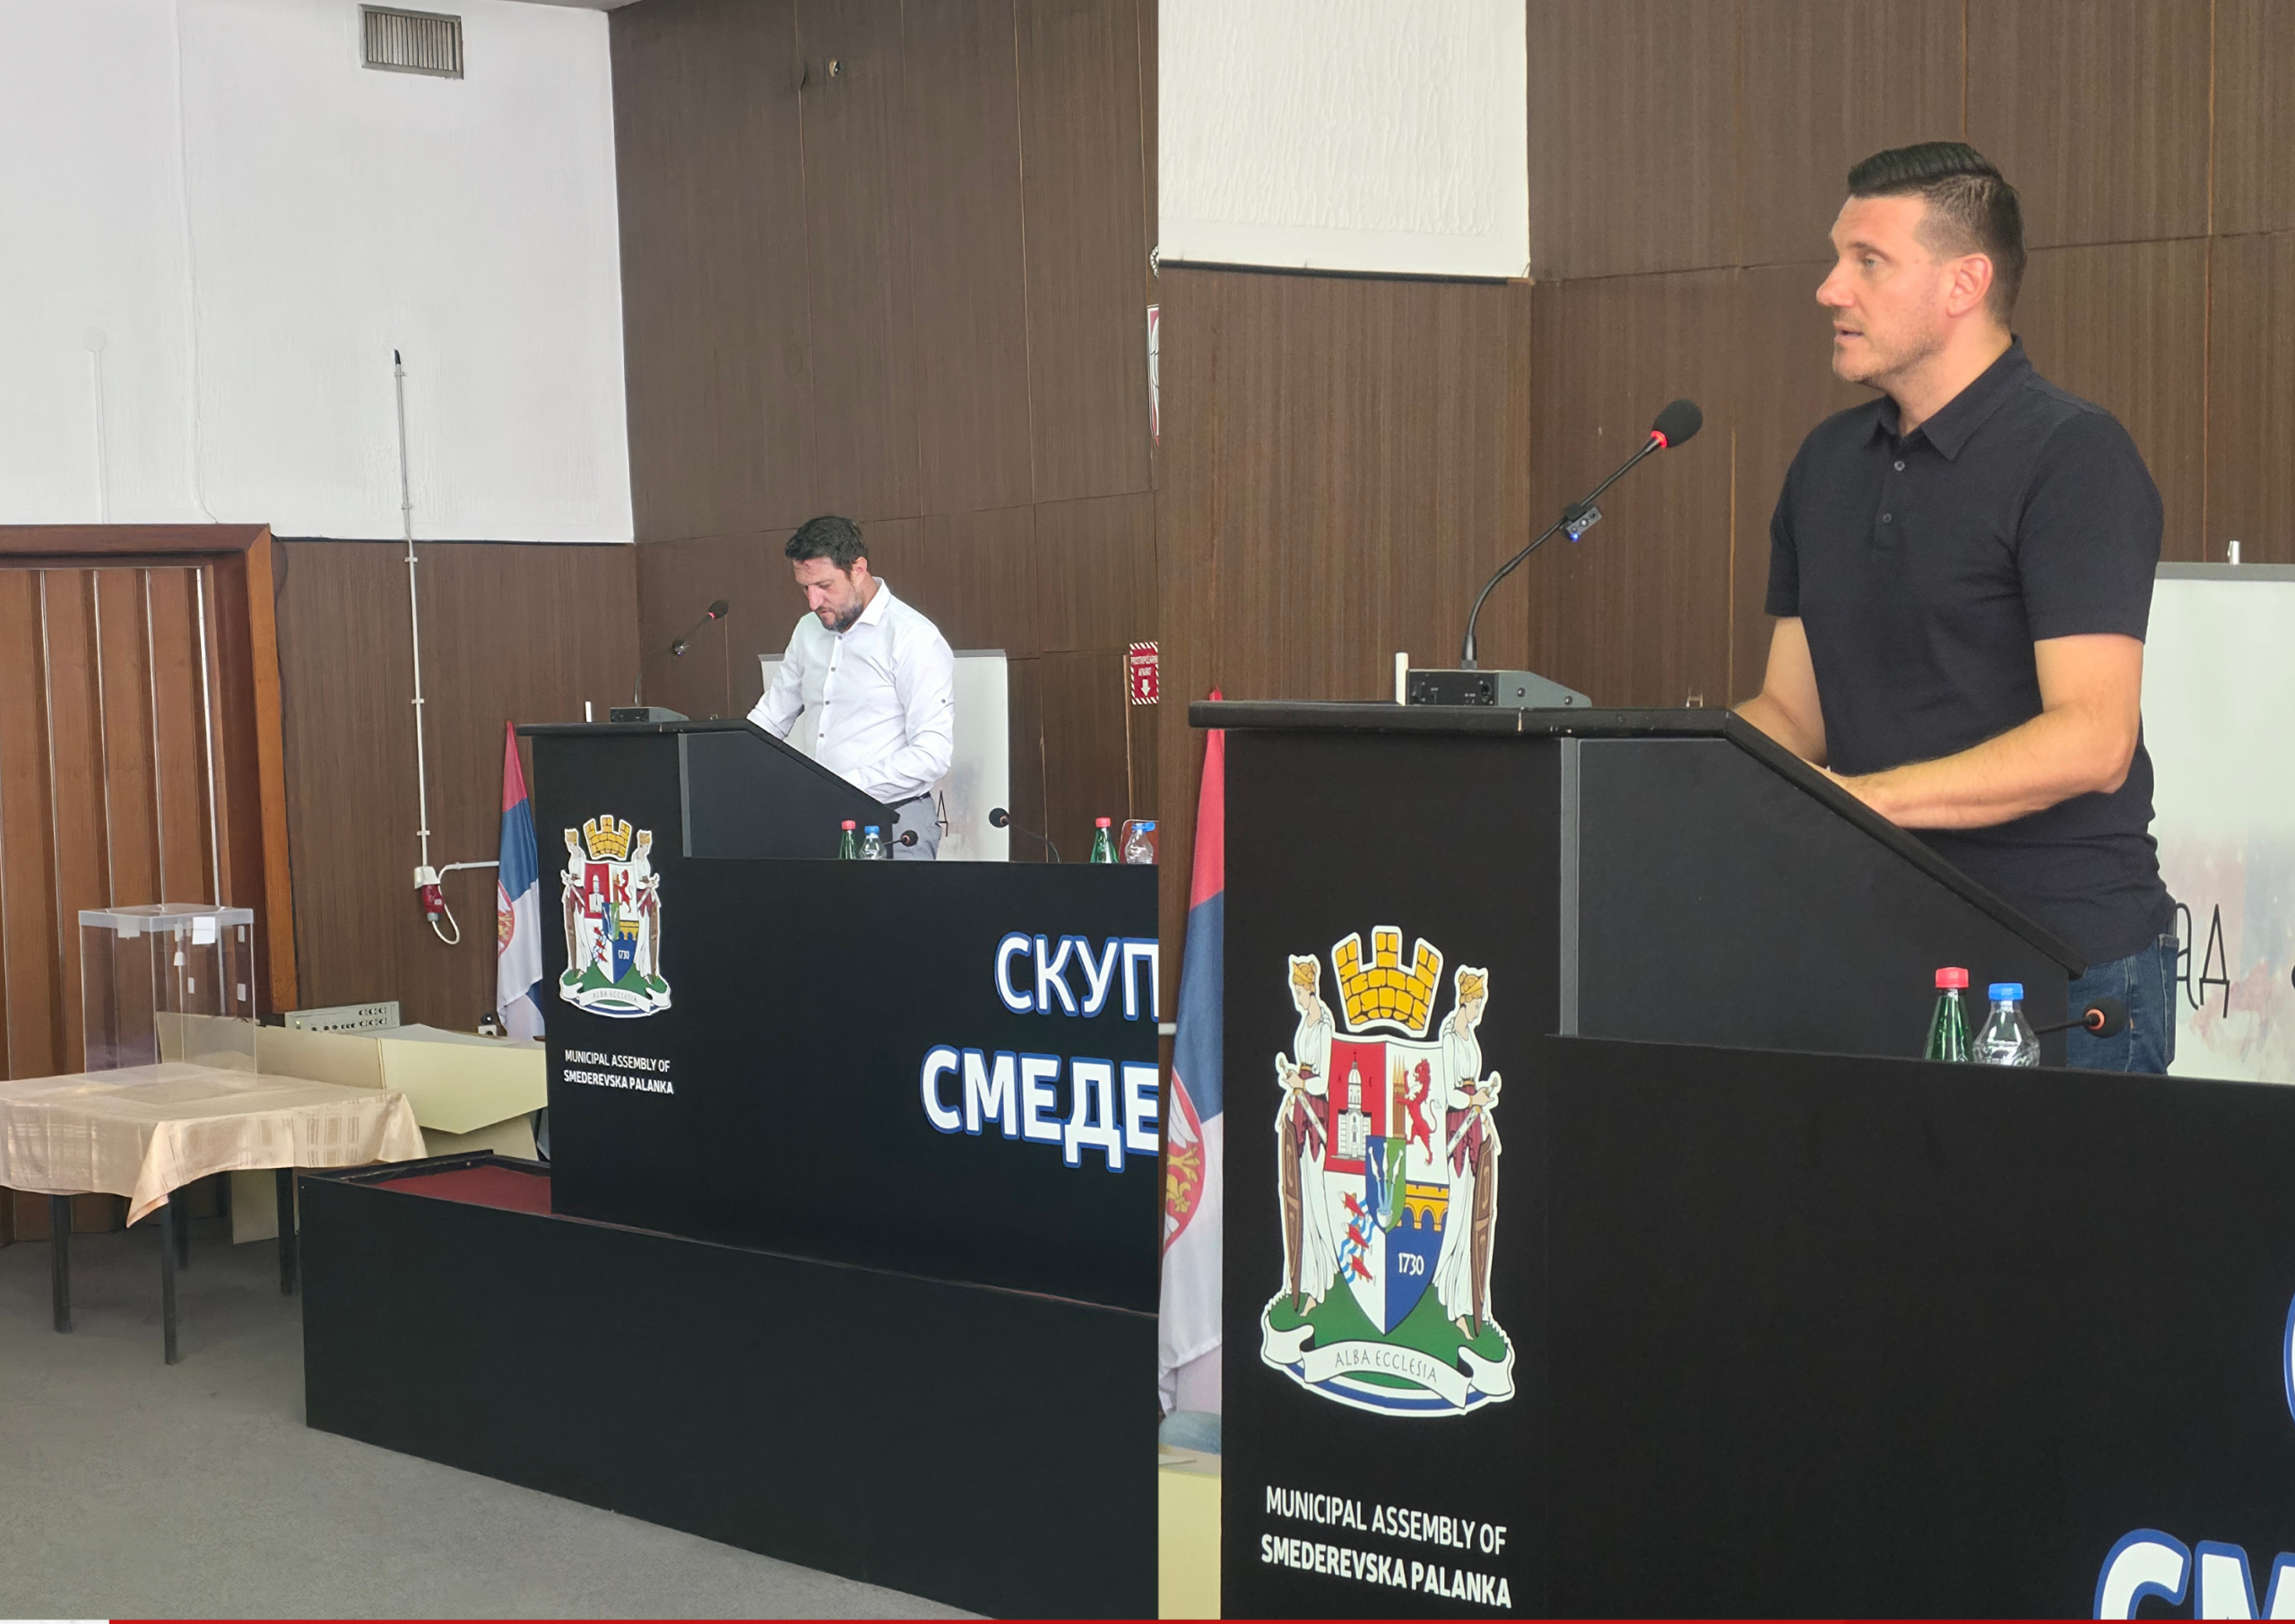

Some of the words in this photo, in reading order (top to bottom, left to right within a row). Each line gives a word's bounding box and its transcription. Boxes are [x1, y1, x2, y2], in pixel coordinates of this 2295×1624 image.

[565, 1050, 610, 1067] MUNICIPAL
[611, 1054, 656, 1071] ASSEMBLY
[658, 1059, 671, 1073] OF
[563, 1069, 628, 1089] SMEDEREVSKA
[629, 1076, 674, 1094] PALANKA
[920, 1044, 1158, 1173] СМЕДЕ
[1398, 1252, 1425, 1275] 1730
[1335, 1350, 1371, 1369] ALBA
[1375, 1351, 1437, 1383] ECCLESIA
[1266, 1485, 1367, 1531] MUNICIPAL
[1372, 1504, 1476, 1550] ASSEMBLY
[1479, 1523, 1507, 1555] OF
[1260, 1533, 1407, 1589] SMEDEREVSKA
[1410, 1560, 1512, 1609] PALANKA
